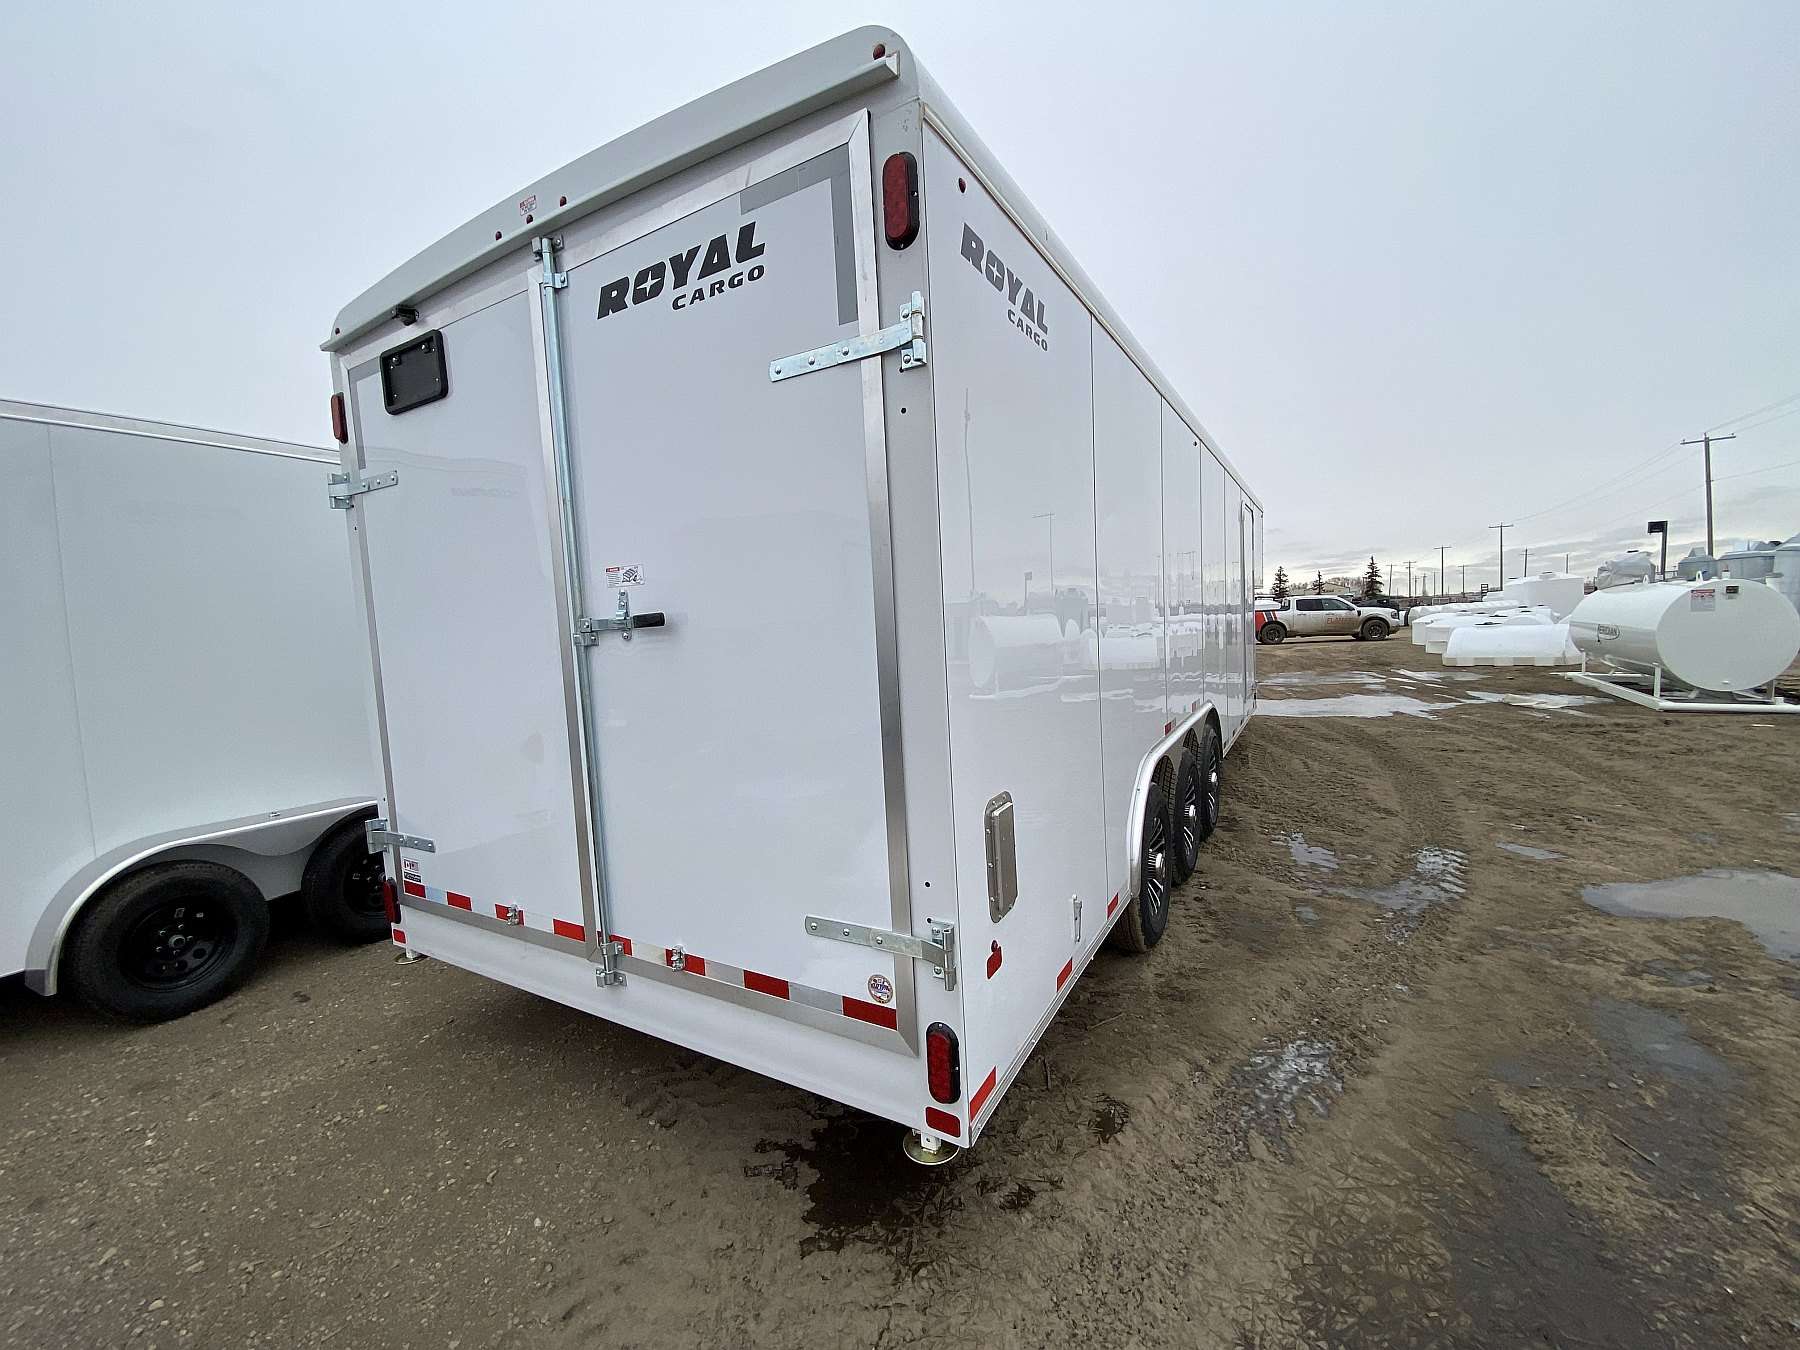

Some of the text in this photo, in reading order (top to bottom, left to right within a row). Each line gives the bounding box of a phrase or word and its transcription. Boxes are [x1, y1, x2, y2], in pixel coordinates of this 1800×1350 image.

[597, 221, 766, 320] ROYAL
[672, 264, 765, 310] CARGO
[961, 222, 1048, 335] ROYAL
[1008, 308, 1048, 351] CARGO
